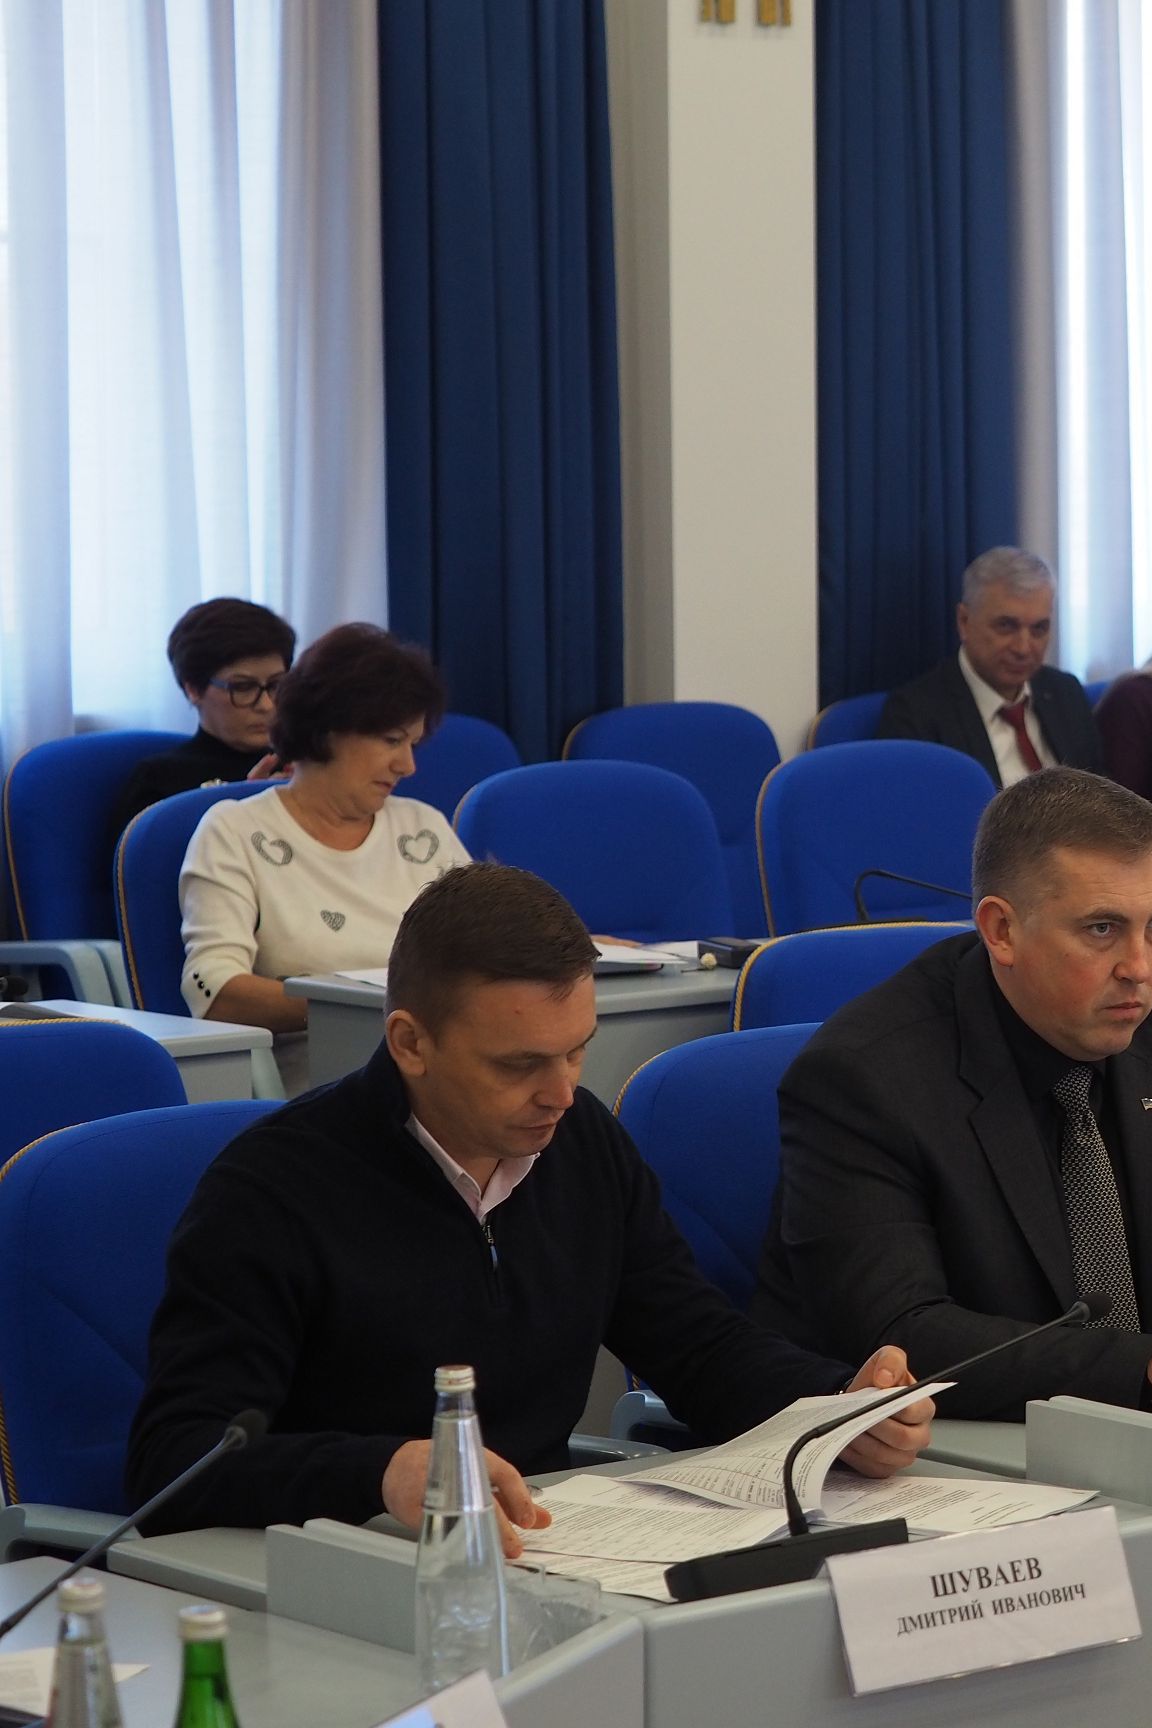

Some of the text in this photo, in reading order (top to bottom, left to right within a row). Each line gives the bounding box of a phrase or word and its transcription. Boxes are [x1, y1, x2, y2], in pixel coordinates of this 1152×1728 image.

[929, 1556, 1043, 1598] ШУВАЕВ
[896, 1583, 1087, 1638] ДМИТРИЙ ИВАНОВИЧ
